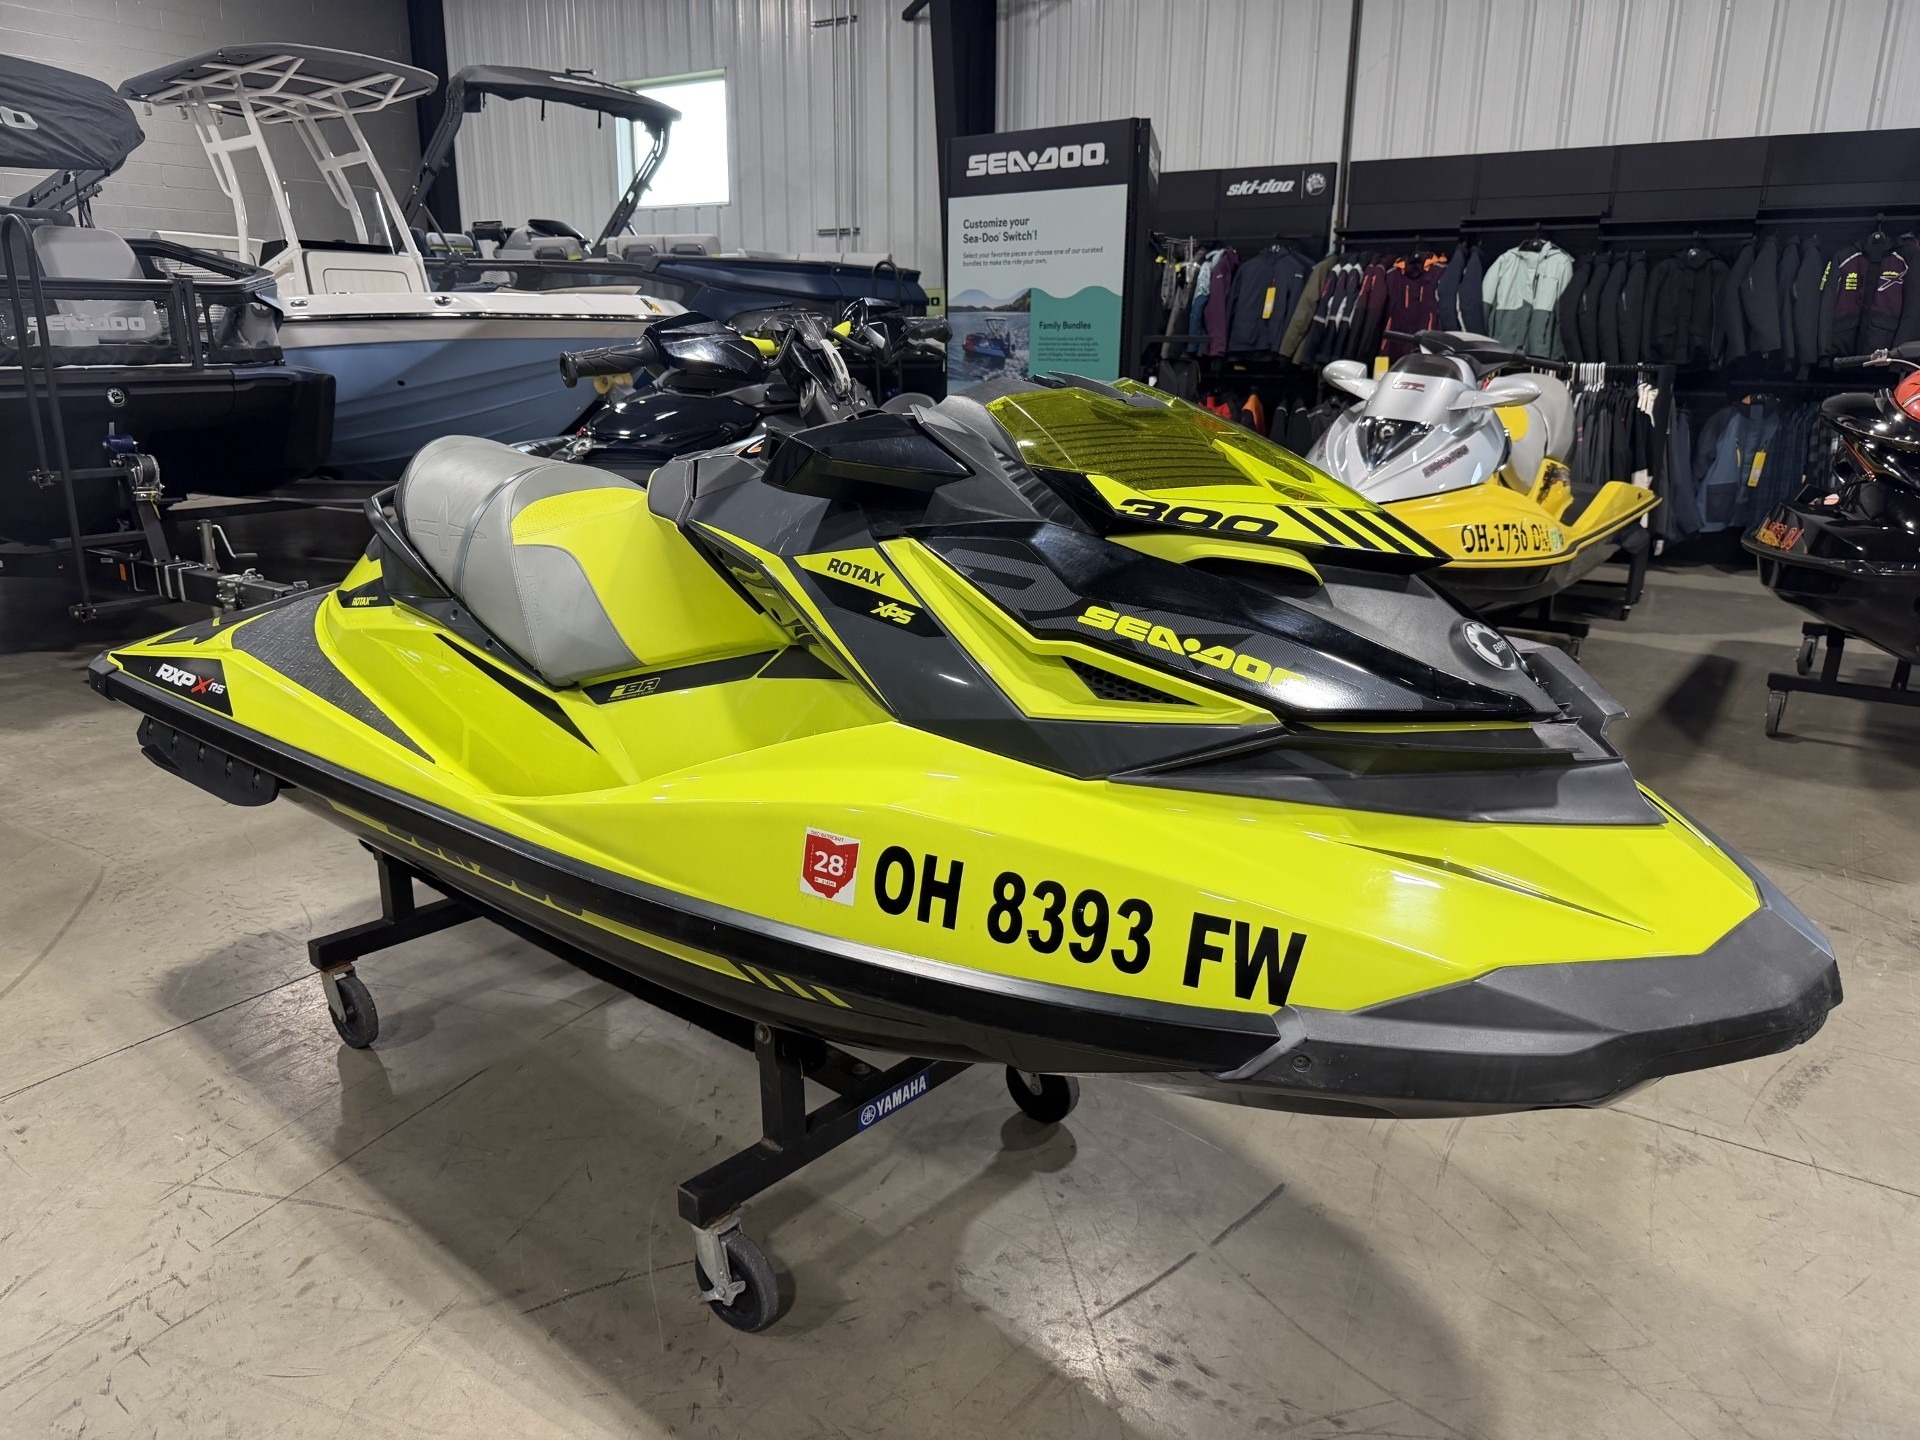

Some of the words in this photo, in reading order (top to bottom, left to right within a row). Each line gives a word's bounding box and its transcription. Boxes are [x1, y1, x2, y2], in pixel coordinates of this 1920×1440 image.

[963, 217, 1008, 229] Customize
[1009, 218, 1030, 229] your
[979, 252, 990, 260] your
[991, 250, 1010, 258] favorite
[1011, 250, 1027, 258] pieces
[1082, 246, 1103, 254] curated
[1022, 258, 1034, 266] your
[1039, 321, 1061, 332] Family
[1063, 321, 1092, 330] Bundles
[1118, 498, 1279, 537] 300
[826, 557, 885, 587] ROTAX
[870, 601, 916, 625] XPS
[1492, 640, 1507, 653] BRP
[814, 851, 844, 876] 28
[874, 845, 964, 930] OH
[987, 871, 1153, 974] 8393
[1183, 912, 1307, 1007] FW
[876, 1075, 927, 1117] YAMAHA
